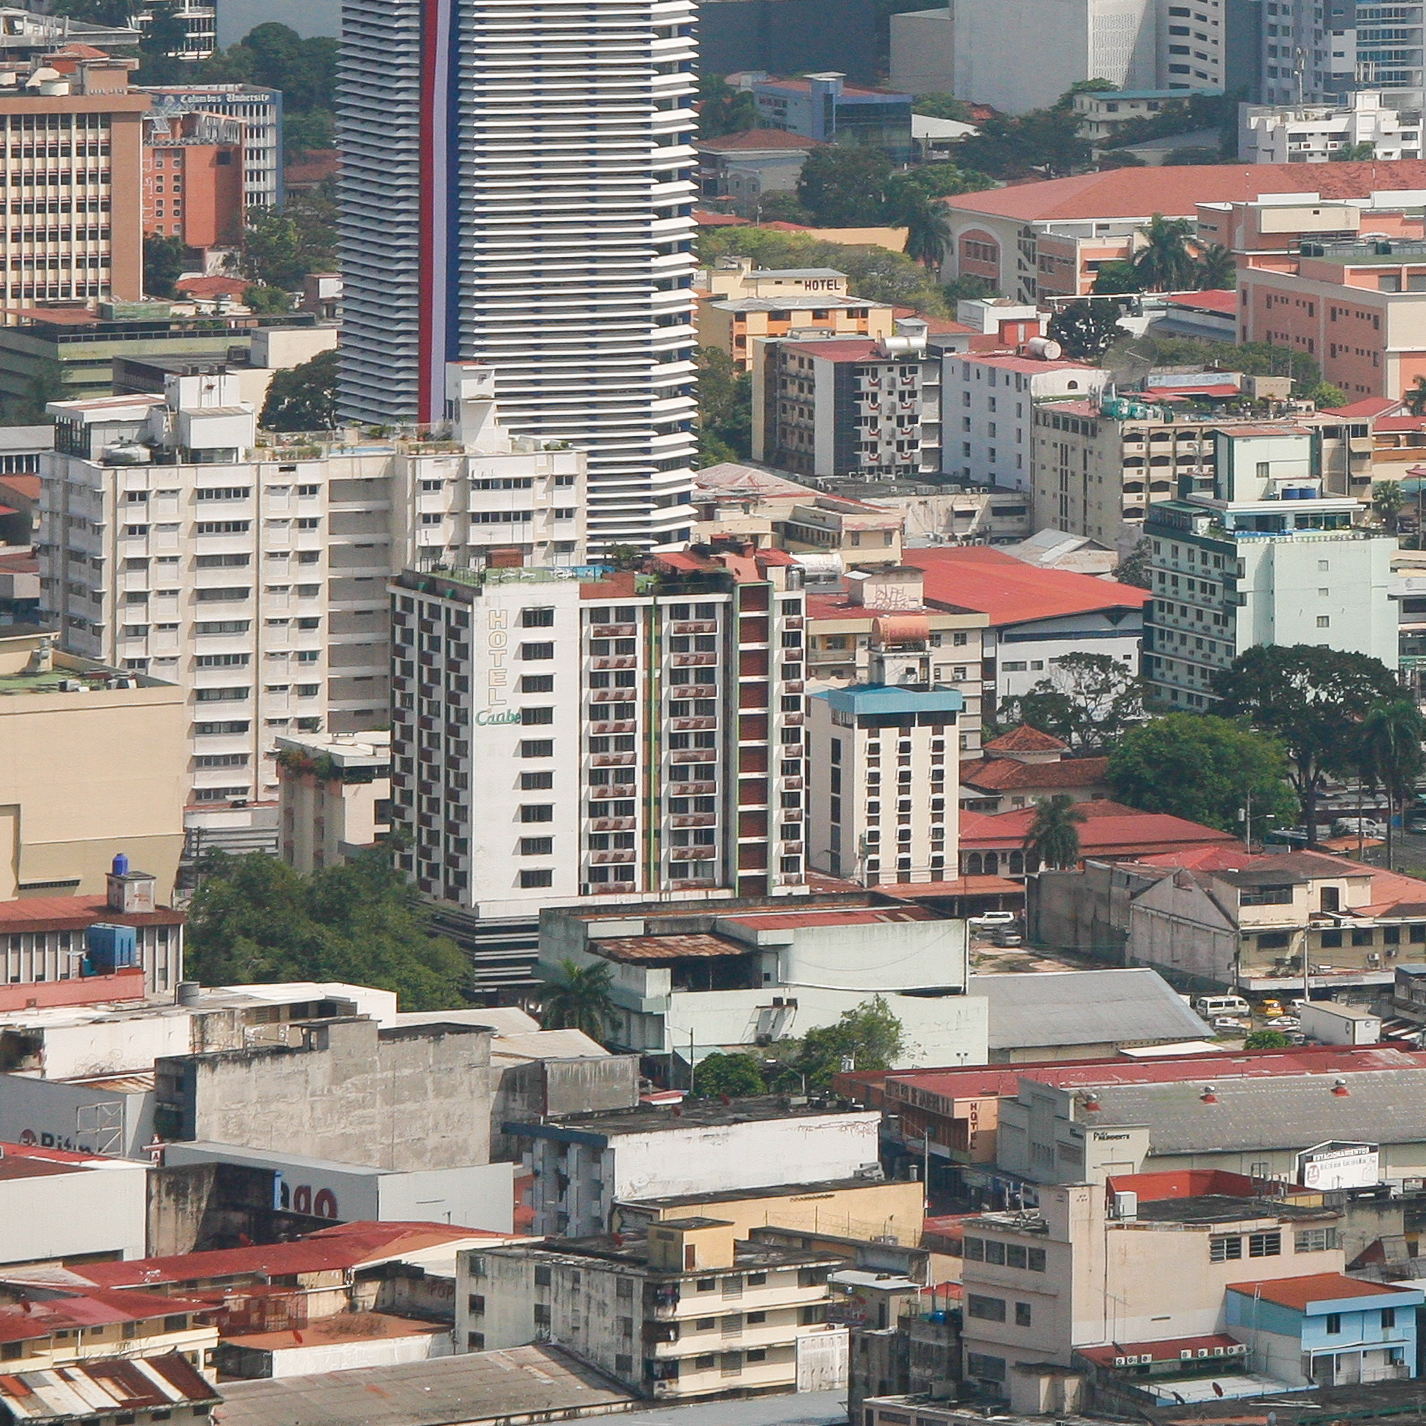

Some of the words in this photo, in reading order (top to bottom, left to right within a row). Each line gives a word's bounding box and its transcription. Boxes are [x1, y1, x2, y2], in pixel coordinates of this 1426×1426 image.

[180, 94, 222, 103] Columbus
[225, 92, 270, 103] University
[804, 279, 841, 292] HOTEL
[488, 609, 508, 706] HOTEL
[970, 1102, 978, 1150] HOTEL
